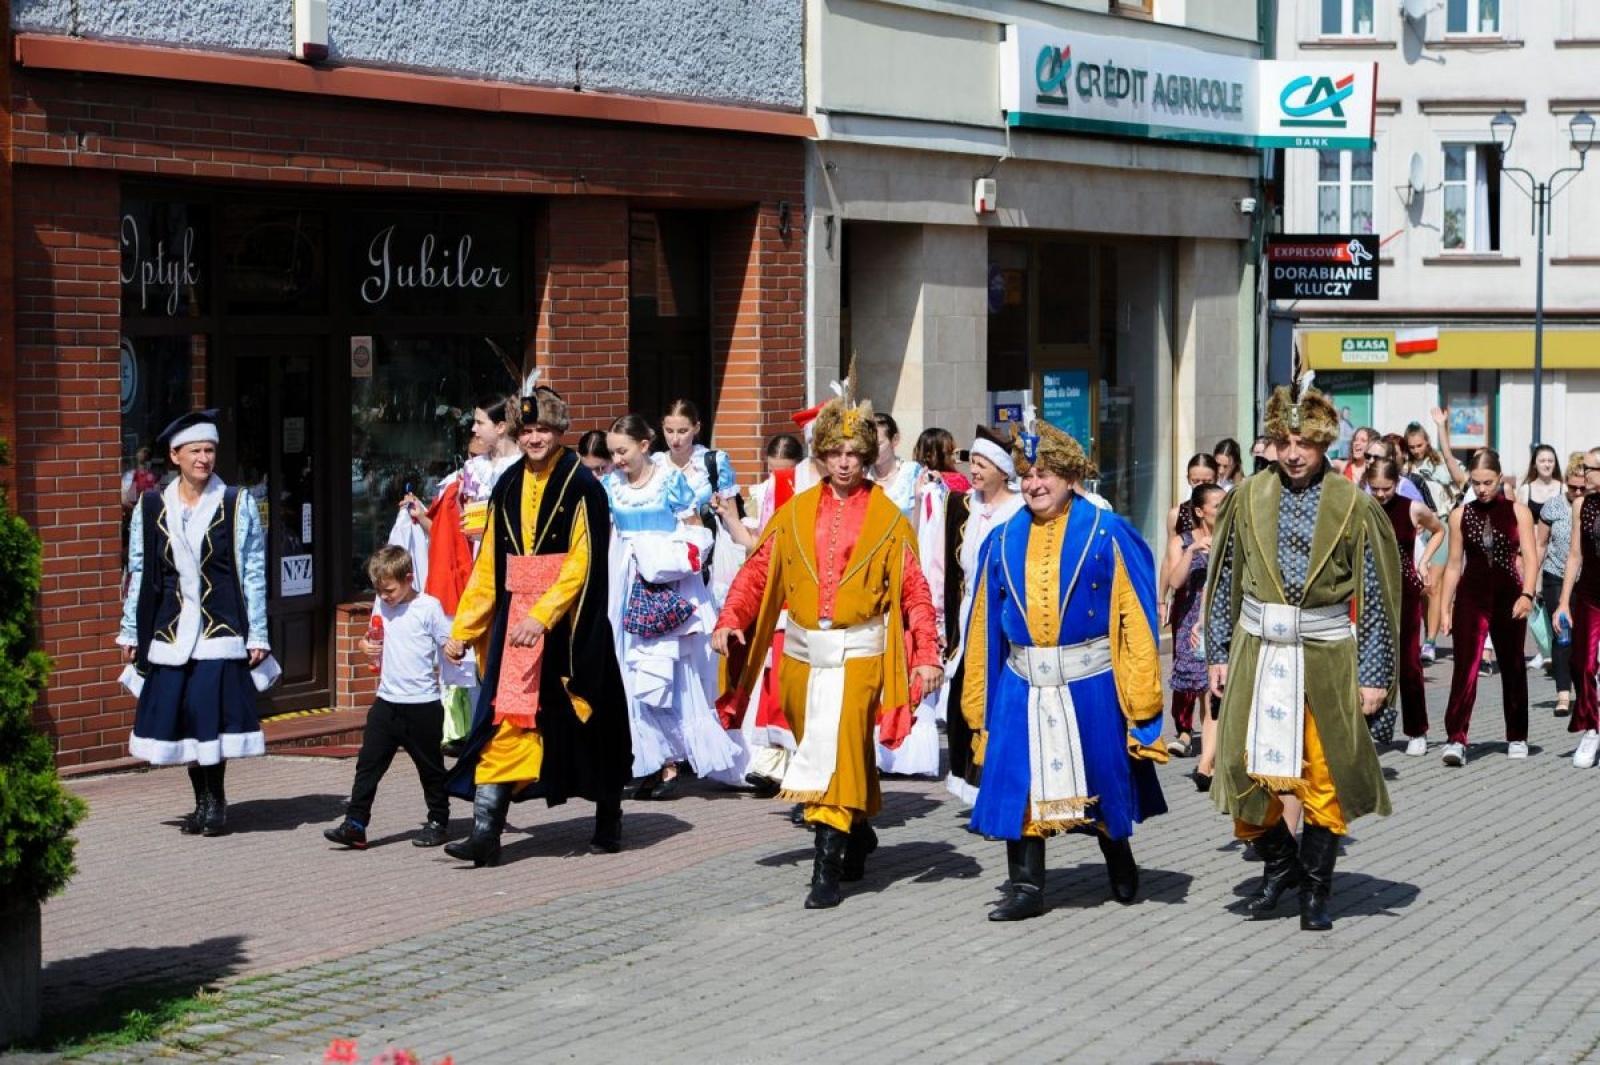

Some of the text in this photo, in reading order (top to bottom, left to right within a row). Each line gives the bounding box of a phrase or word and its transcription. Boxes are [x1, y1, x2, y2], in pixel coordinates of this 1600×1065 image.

[1076, 59, 1148, 103] CRÉDIT
[1153, 72, 1243, 114] AGRICOLE
[1295, 138, 1329, 147] BANK
[1274, 247, 1345, 258] EXPRESOWE
[361, 224, 509, 303] Jubiler
[1274, 267, 1373, 280] DORABIANIE
[1294, 282, 1352, 296] KLUCZY
[1356, 339, 1387, 350] KASA
